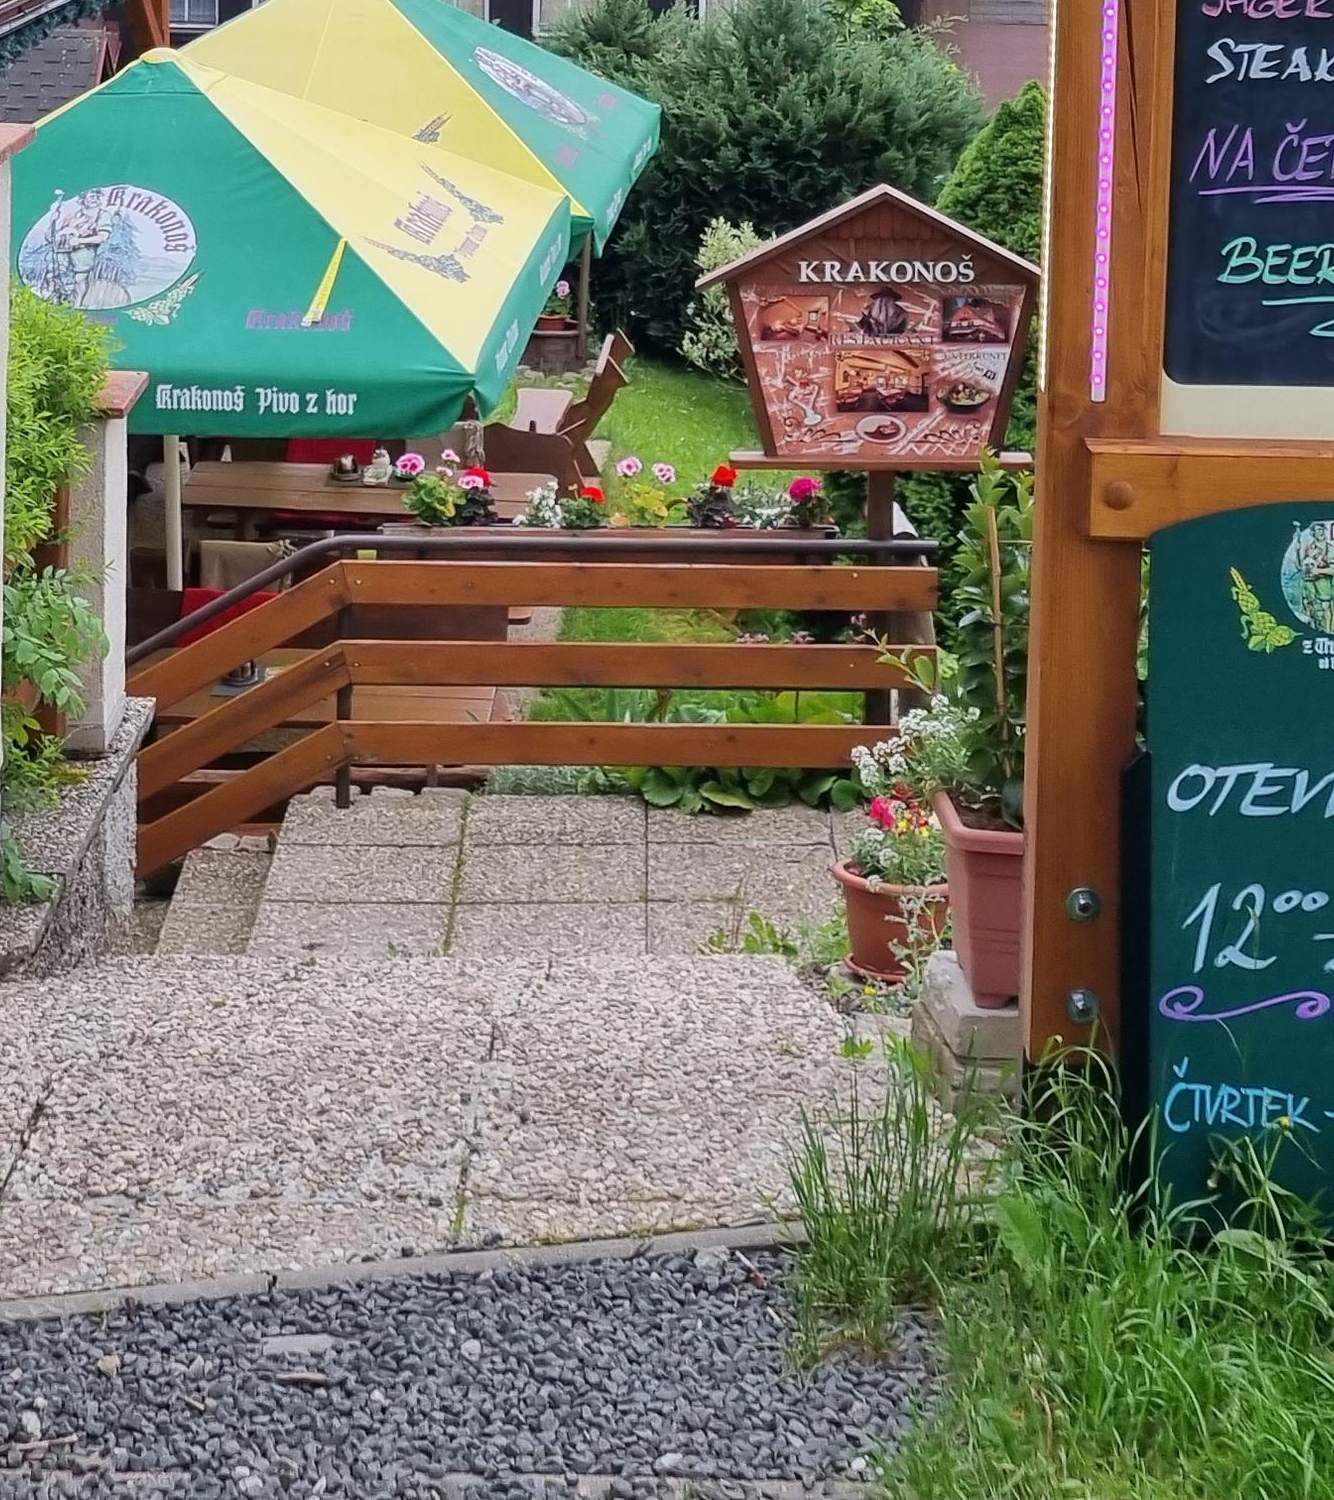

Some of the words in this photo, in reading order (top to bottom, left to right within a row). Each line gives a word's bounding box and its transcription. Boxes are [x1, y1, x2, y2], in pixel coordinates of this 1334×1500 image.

[1188, 123, 1255, 183] NA
[798, 253, 976, 284] KRAKONOŠ
[155, 384, 246, 413] Krakonoš
[255, 386, 301, 415] Pivo
[305, 392, 319, 414] z
[325, 388, 358, 416] hor
[1164, 1056, 1321, 1133] ČTVRTEK
